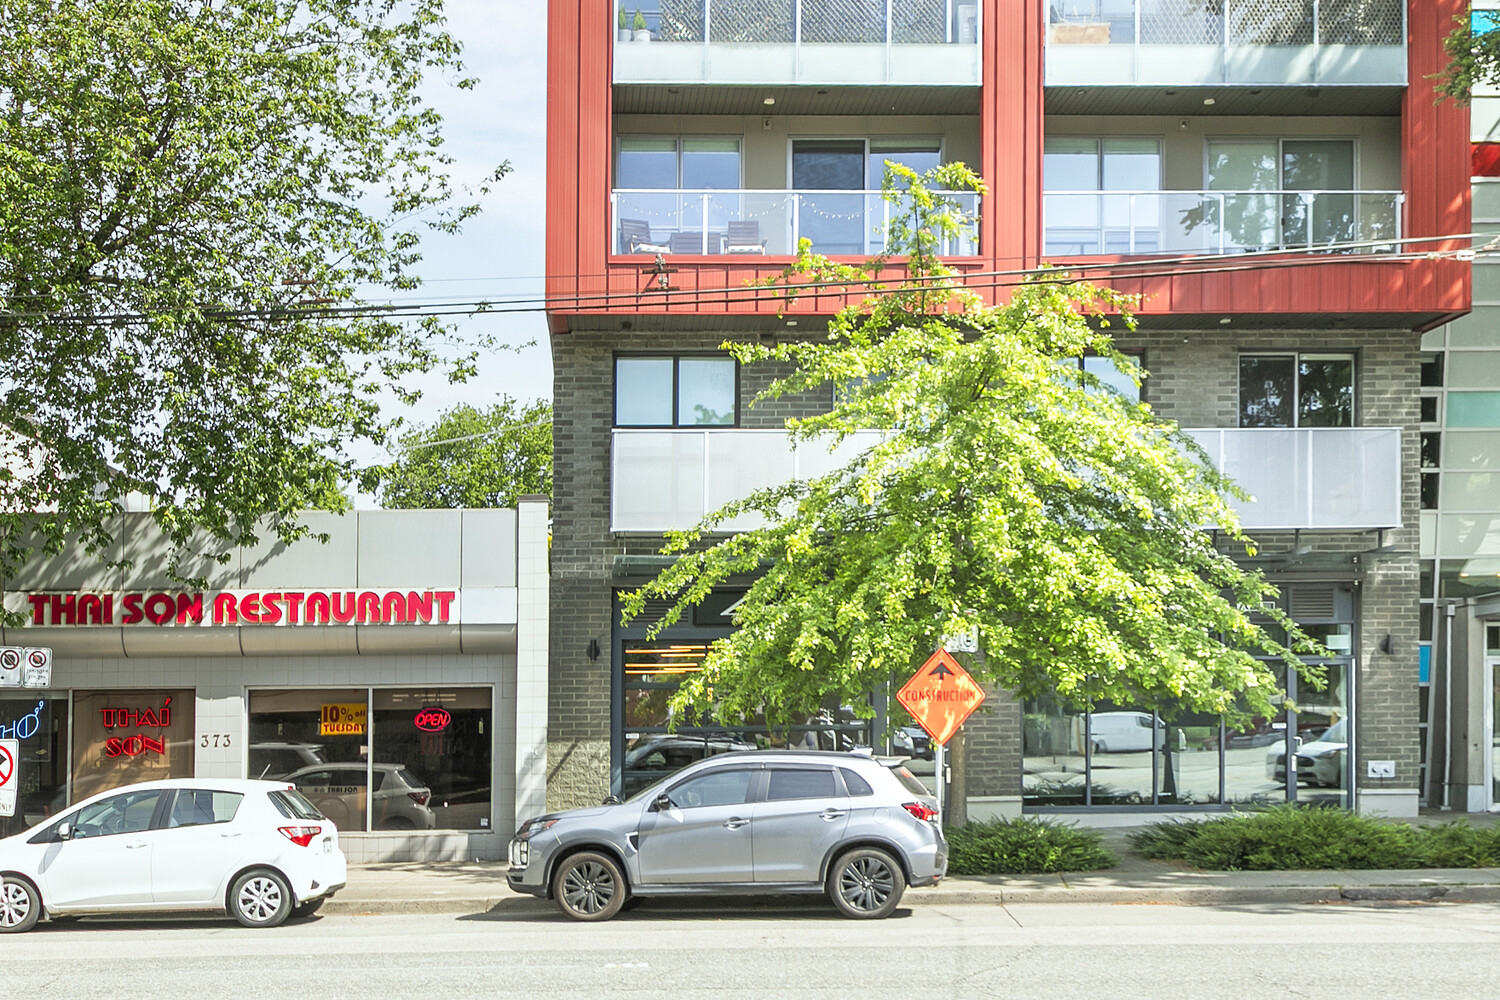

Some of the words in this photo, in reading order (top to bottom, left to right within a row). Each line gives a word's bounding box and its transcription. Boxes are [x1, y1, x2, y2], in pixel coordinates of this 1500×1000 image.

[28, 594, 113, 625] THAI
[122, 593, 204, 625] SON
[212, 591, 456, 624] RESTAURANT
[905, 690, 976, 701] CONSTRUCTION
[416, 713, 448, 727] OPEN
[323, 723, 365, 733] TUESDAY
[201, 734, 231, 748] 373
